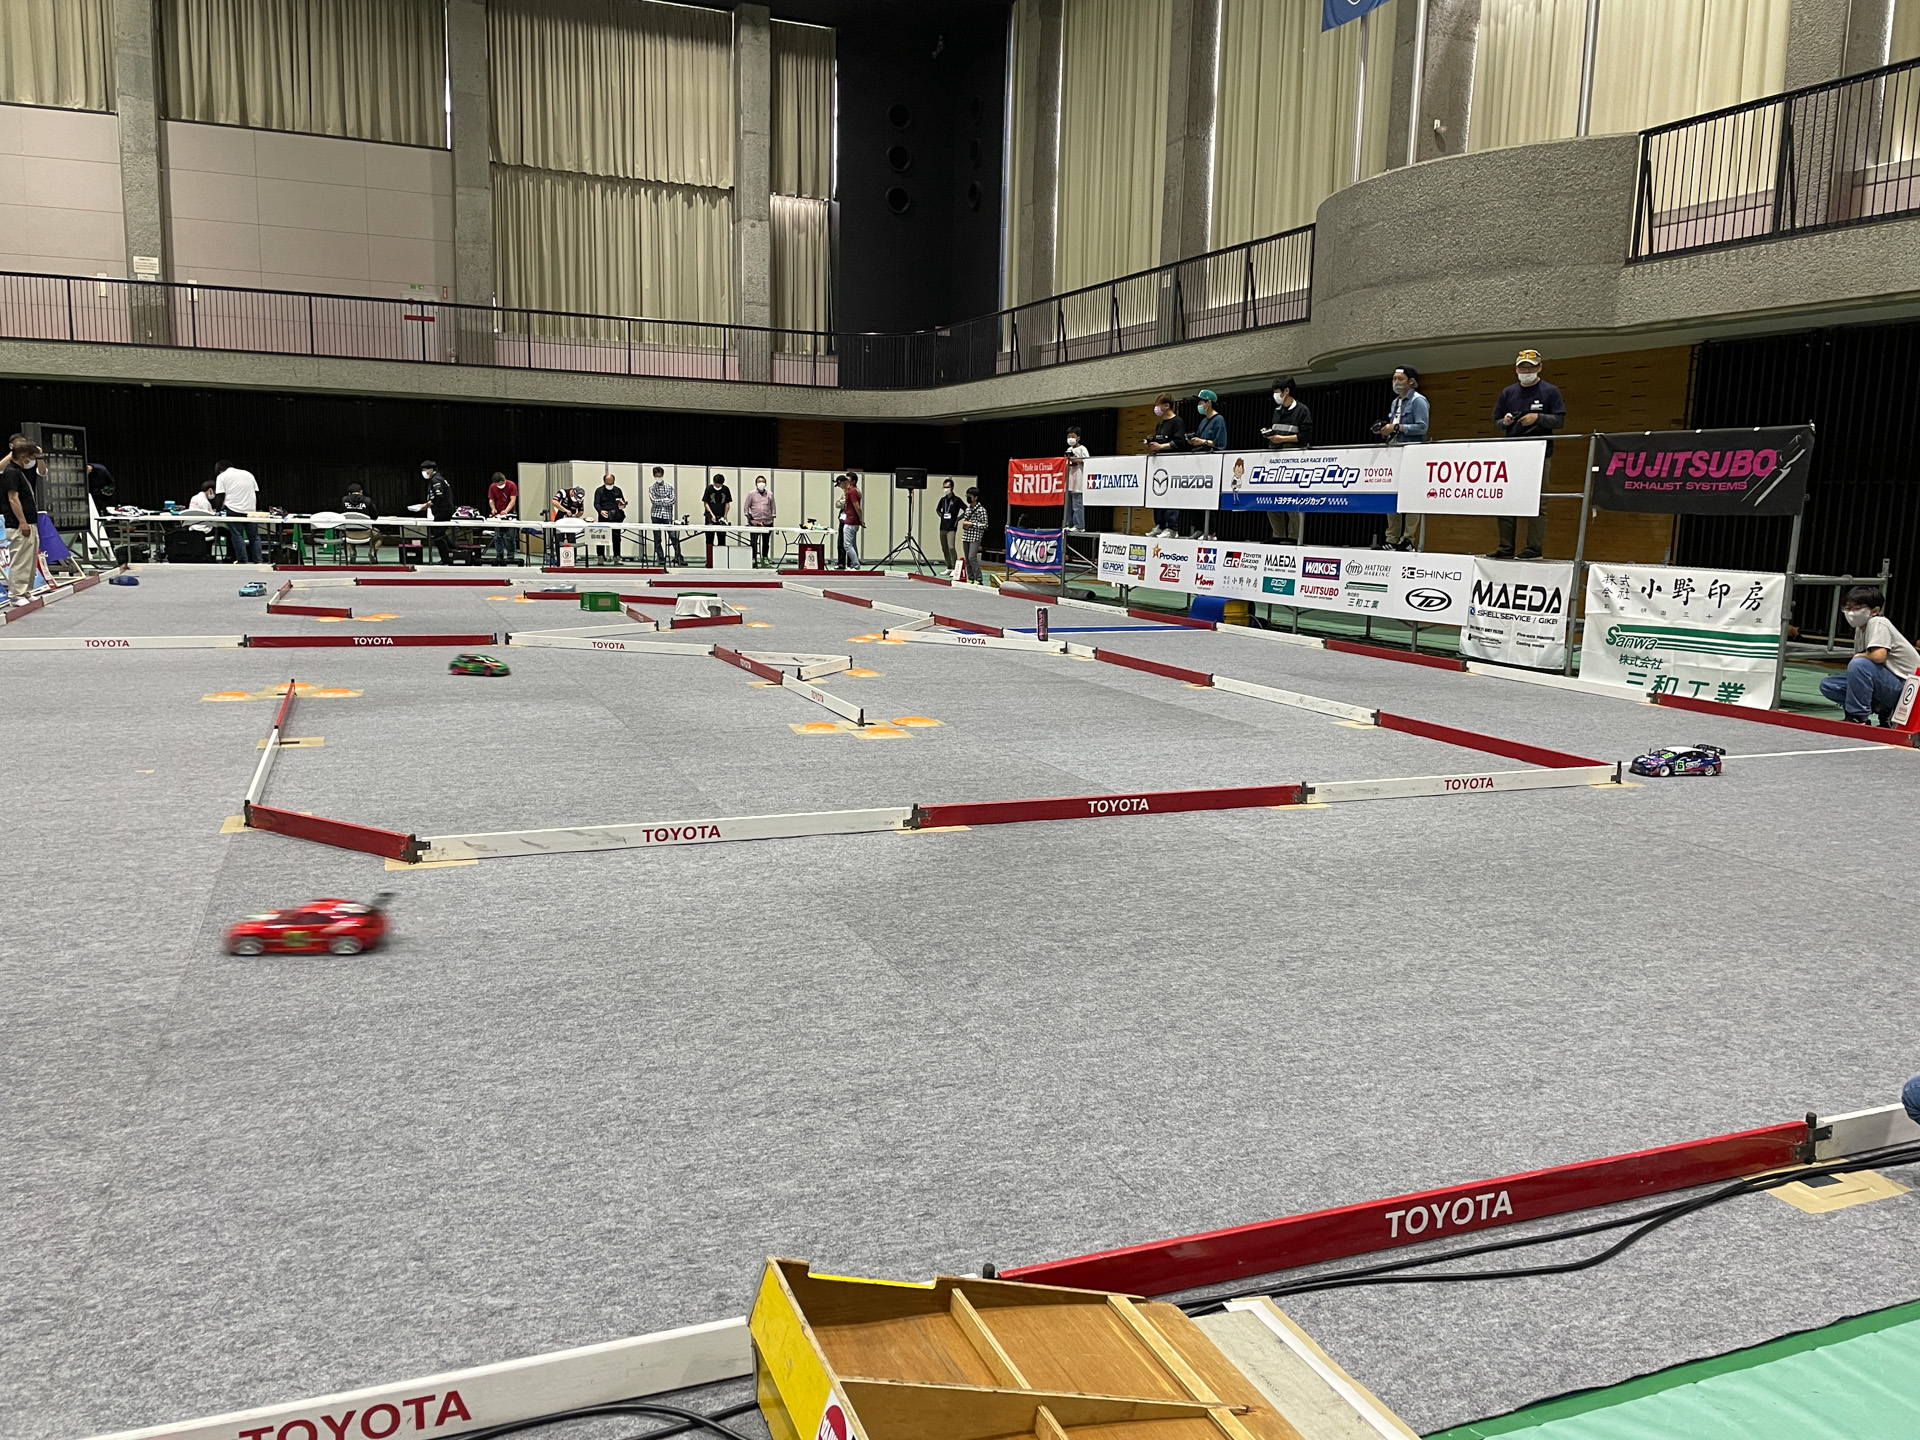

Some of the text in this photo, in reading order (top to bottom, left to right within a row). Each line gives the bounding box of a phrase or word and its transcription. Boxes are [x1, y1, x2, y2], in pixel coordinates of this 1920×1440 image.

[1606, 449, 1777, 478] FUJITSUBO
[1364, 468, 1392, 476] TOYOTA
[1426, 461, 1508, 483] TOYOTA
[1012, 472, 1063, 493] BRIDE
[1102, 474, 1139, 488] TAMIYA
[1625, 482, 1747, 491] EXHAUST SYSTEMS
[1439, 488, 1503, 499] RC CAR CLUB
[1274, 497, 1326, 505] トヨタチャレンジカップ
[1223, 558, 1241, 568] GR
[1264, 554, 1297, 568] MAEDA
[1416, 569, 1461, 580] SHINKO
[1300, 585, 1339, 596] FUJITSUBO
[1472, 579, 1562, 613] MAEDA
[1641, 578, 1765, 611] 小野印房
[1477, 610, 1499, 619] SHELL
[1500, 614, 1531, 623] SERVICE
[353, 637, 394, 645] TOYOTA
[957, 637, 986, 645] TOYOTA
[1606, 626, 1658, 650] Sanwa
[592, 642, 625, 650] TOYOTA
[1619, 654, 1663, 670] 株式会社
[1444, 777, 1494, 791] TOYOTA
[1088, 798, 1150, 814] TOYOTA
[643, 825, 721, 843] TOYOTA
[1385, 1190, 1513, 1238] TOYOTA
